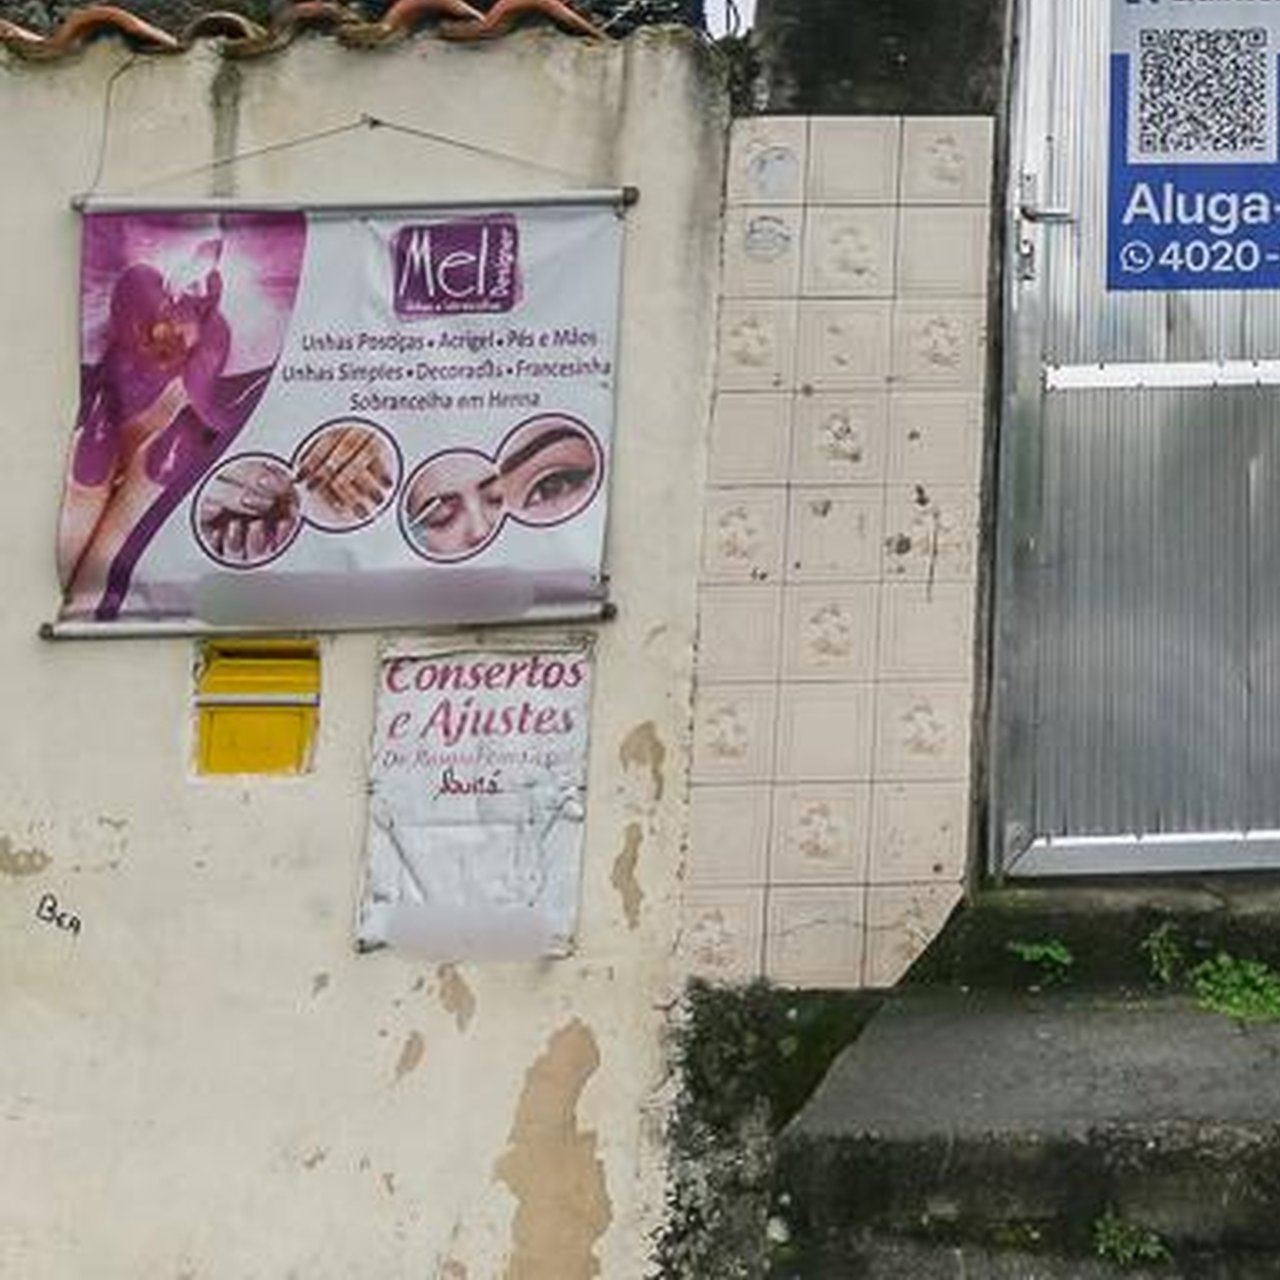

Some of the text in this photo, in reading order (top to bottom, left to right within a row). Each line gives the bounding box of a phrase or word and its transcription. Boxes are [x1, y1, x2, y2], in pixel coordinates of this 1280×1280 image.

[398, 226, 489, 298] Mel
[302, 333, 353, 351] Unhas
[438, 330, 495, 353] Acrigel
[538, 334, 549, 347] e
[553, 327, 597, 346] Mãos
[283, 364, 334, 382] Unhas
[338, 362, 404, 384] Simples
[516, 356, 611, 378] Francesinha
[350, 389, 541, 411] Sobrancelha em Henna
[386, 656, 585, 693] Consertos
[388, 697, 575, 747] e Ajustes
